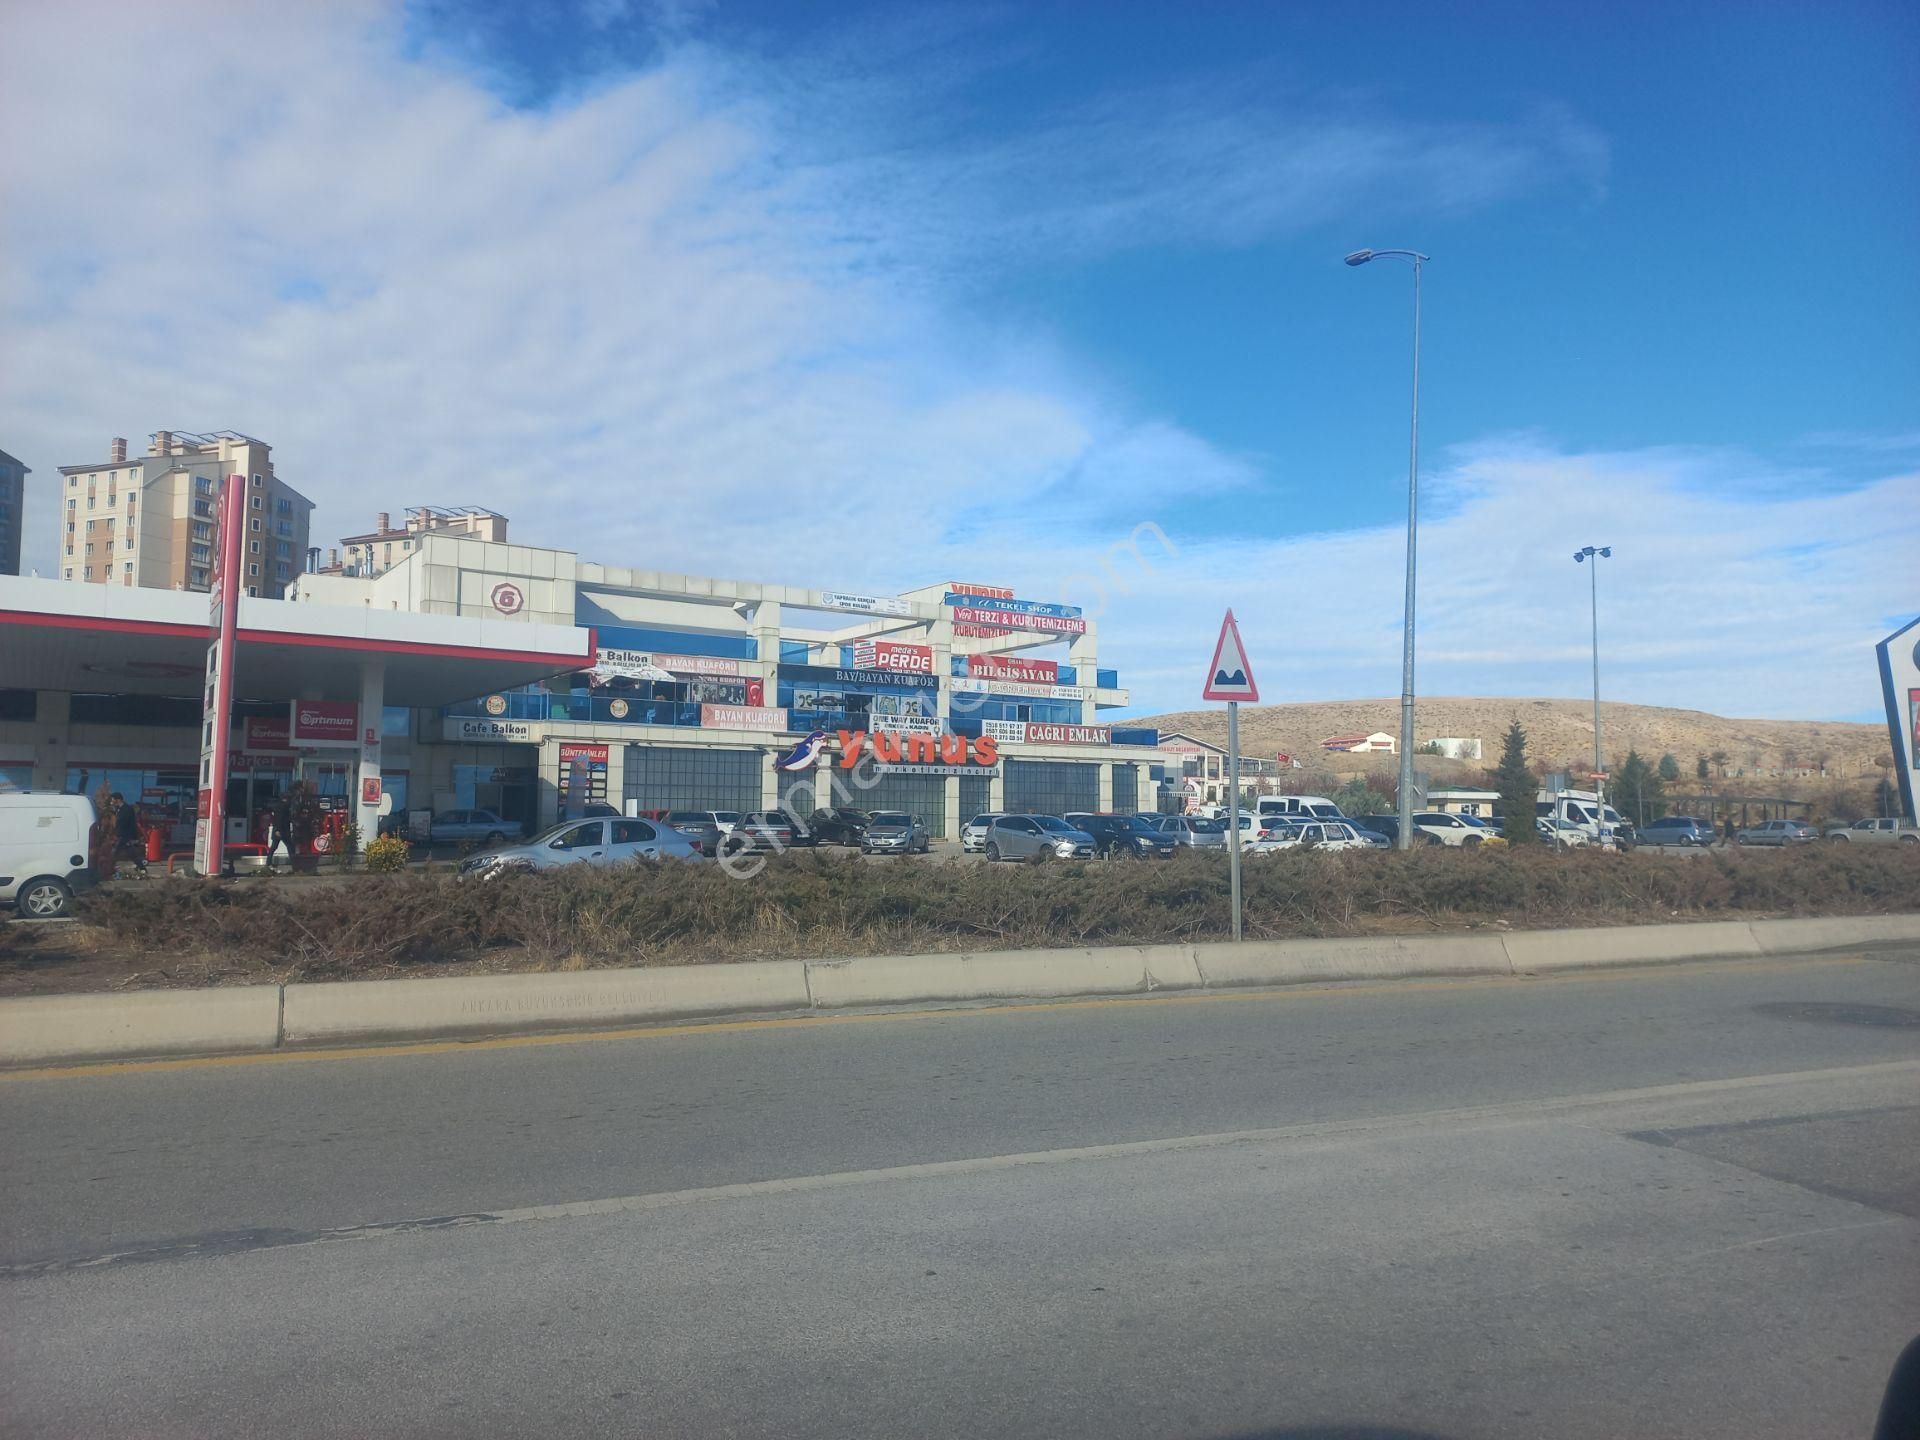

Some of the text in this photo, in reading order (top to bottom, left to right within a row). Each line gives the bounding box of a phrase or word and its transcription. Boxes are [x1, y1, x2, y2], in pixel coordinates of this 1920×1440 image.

[995, 601, 1026, 611] TEKEL
[1028, 605, 1052, 614] SHOP
[1002, 614, 1009, 624] &
[606, 650, 648, 663] Balkon
[878, 652, 931, 670] PERDE
[665, 658, 696, 669] BAYAN
[836, 671, 891, 684] BAY/BAYAN
[973, 664, 1055, 681] BİLGİSAYAR
[714, 709, 743, 722] BAYAN
[873, 715, 889, 723] ONE
[463, 722, 527, 735] Cafe Balkon
[1068, 728, 1107, 744] EMLAK
[836, 729, 998, 768] yunus
